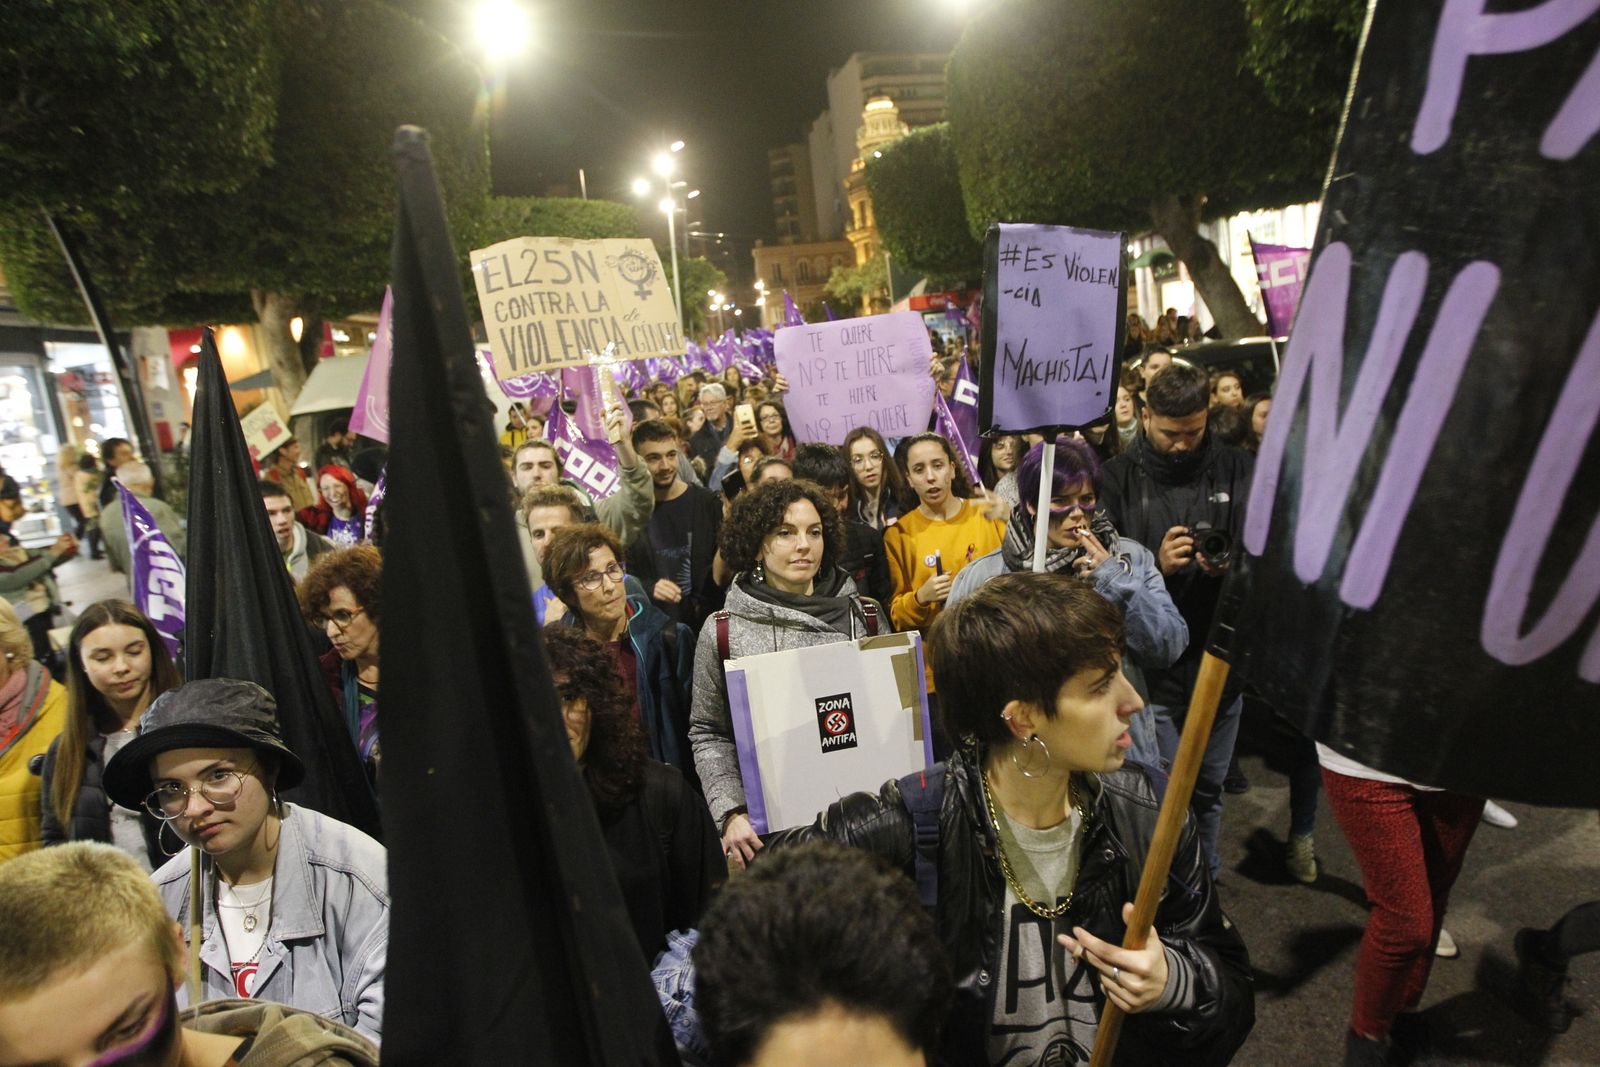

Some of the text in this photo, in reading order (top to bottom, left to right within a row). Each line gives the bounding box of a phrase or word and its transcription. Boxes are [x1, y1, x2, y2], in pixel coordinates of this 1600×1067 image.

[494, 290, 611, 323] CONTRA LA
[499, 315, 631, 371] VIOLENCIA
[623, 308, 640, 321] de
[808, 322, 875, 353] TE QUIERE
[834, 360, 849, 381] TE
[816, 384, 878, 406] TE HIERE
[868, 403, 911, 433] QUIERE
[818, 697, 850, 713] ZONA
[822, 732, 856, 747] ANTIFA
